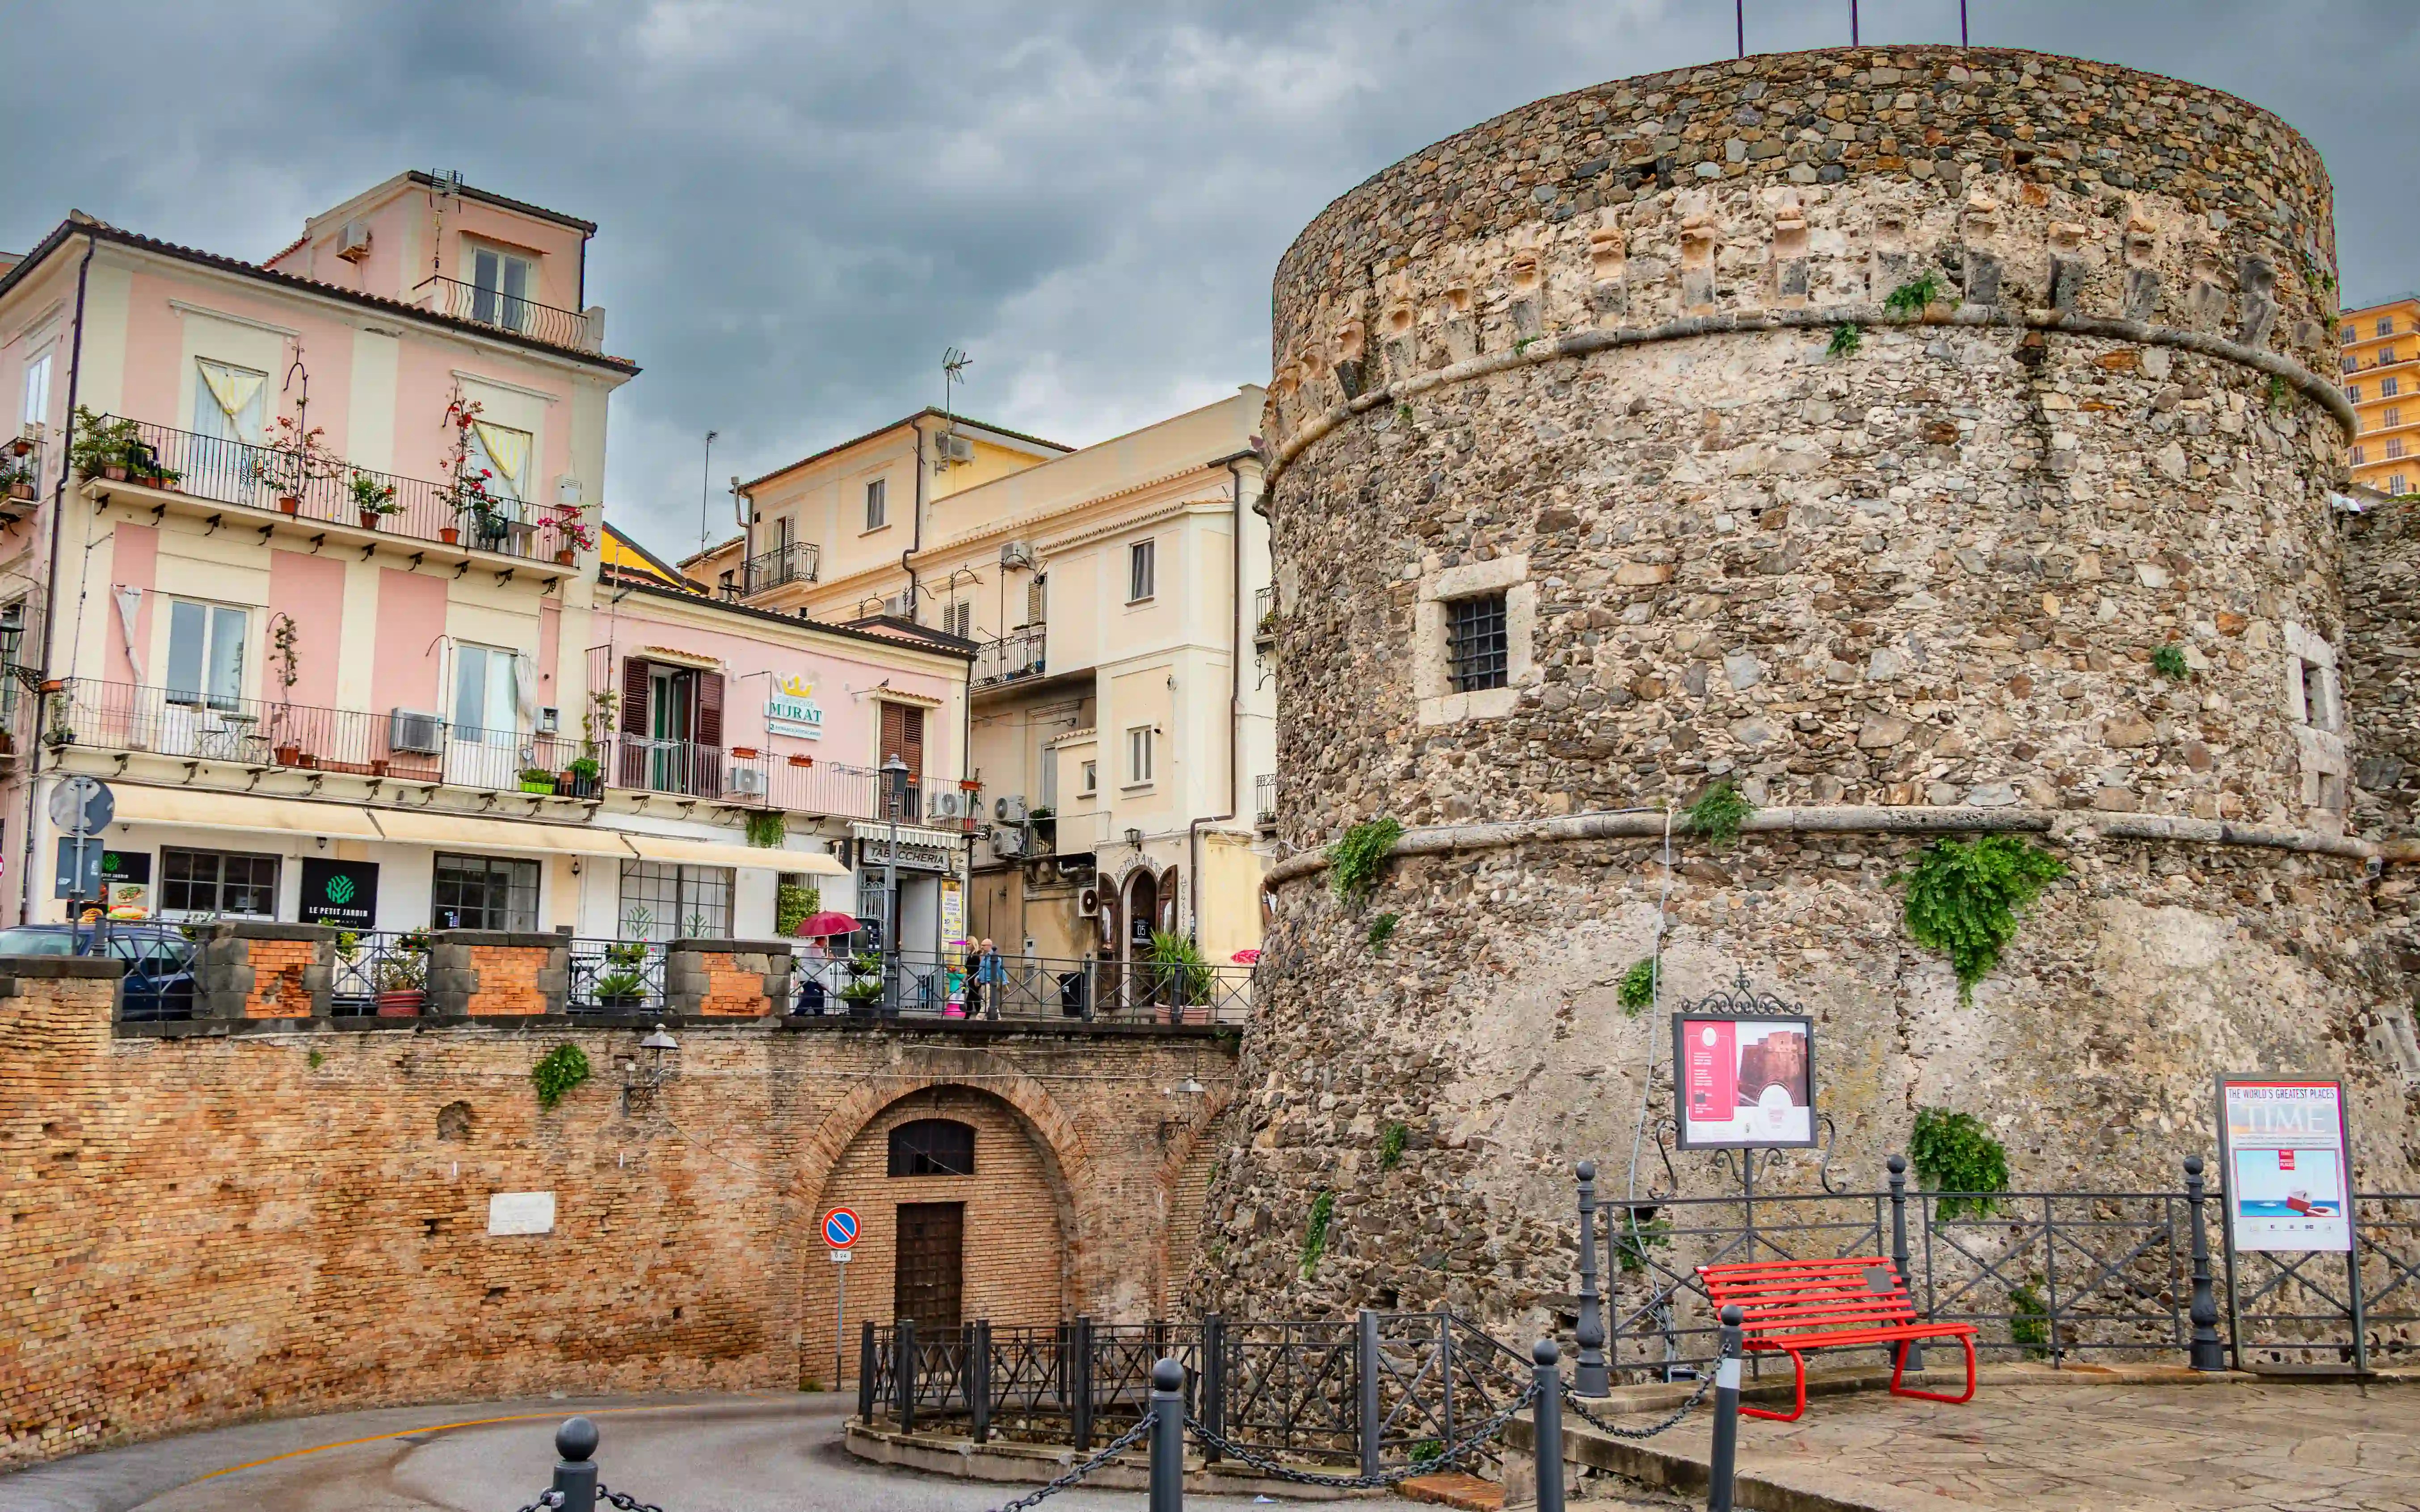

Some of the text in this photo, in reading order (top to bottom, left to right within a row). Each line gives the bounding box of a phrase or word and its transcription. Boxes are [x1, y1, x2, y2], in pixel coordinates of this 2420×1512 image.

[770, 702, 822, 722] MURAT
[871, 847, 943, 864] TABCCHERIA
[1114, 853, 1164, 883] RISTORANTE
[320, 907, 341, 915] PETIT
[342, 909, 369, 917] JARDIN
[1137, 925, 1145, 935] 05
[2229, 1089, 2335, 1099] THE WORLD'S GREATEST PLACES
[2242, 1104, 2326, 1133] TIME
